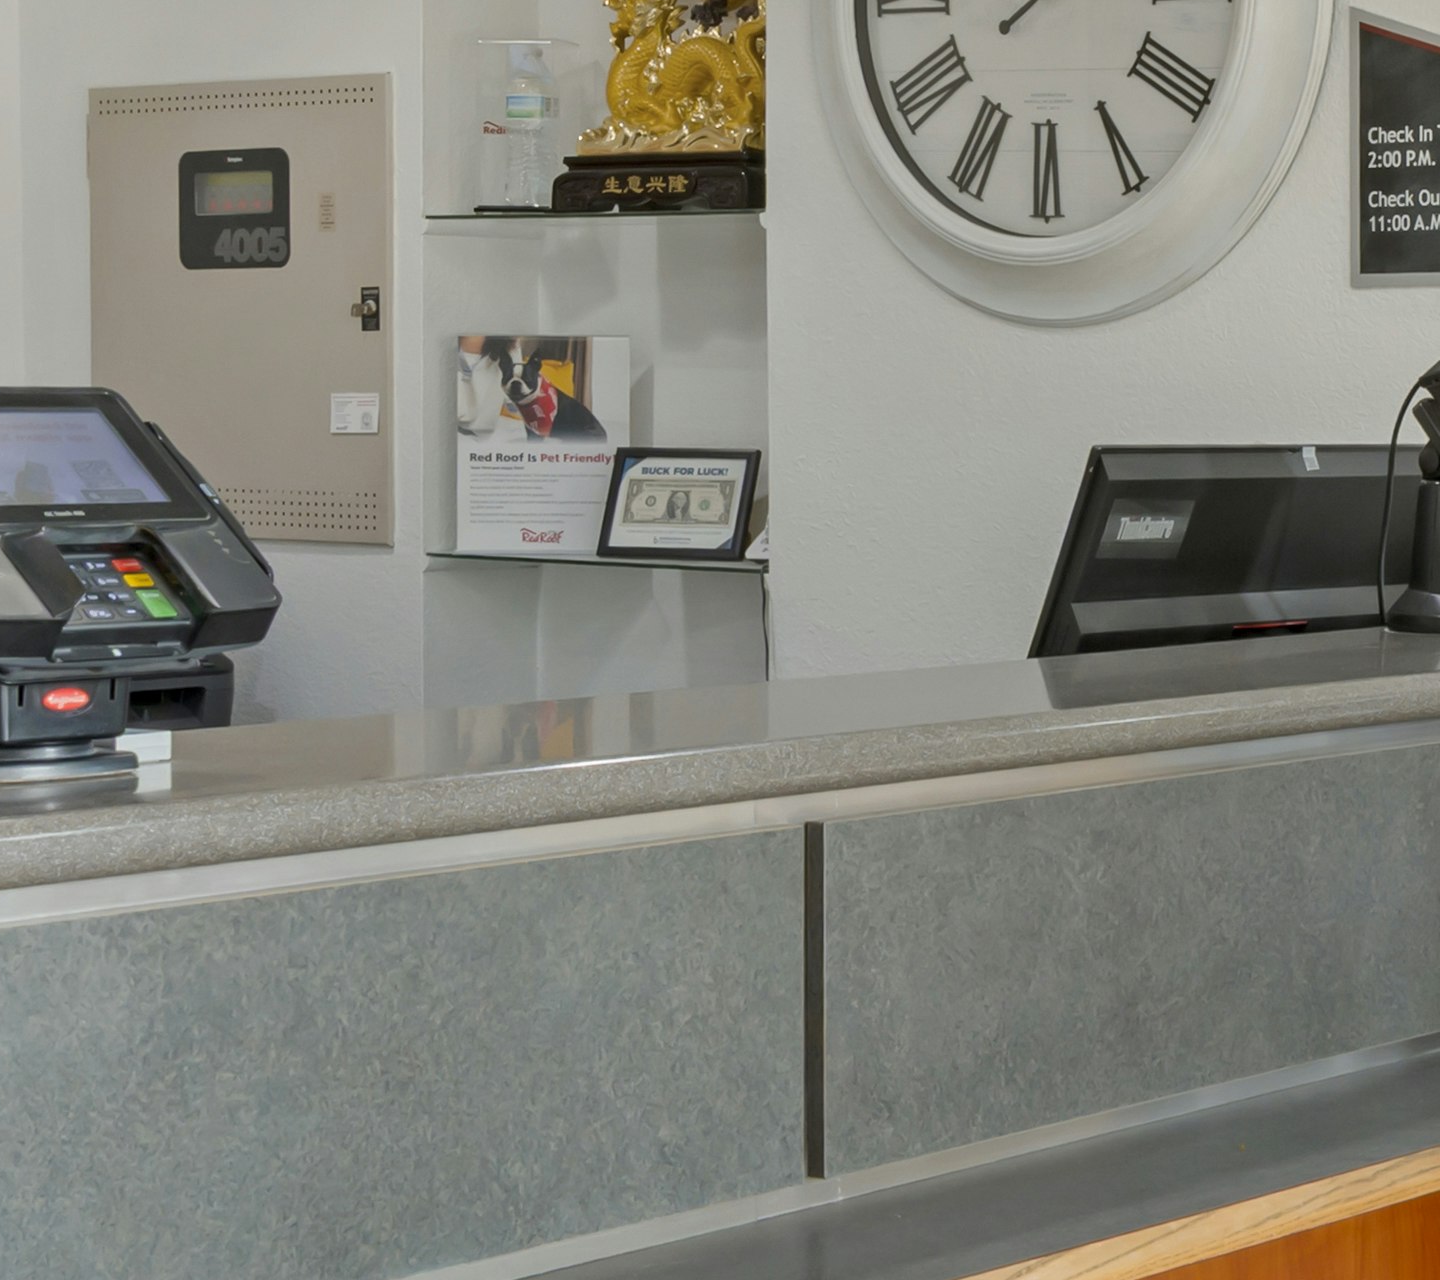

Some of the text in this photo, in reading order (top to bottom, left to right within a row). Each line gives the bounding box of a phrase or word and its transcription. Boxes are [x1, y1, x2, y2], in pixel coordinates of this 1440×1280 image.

[1368, 126, 1414, 144] Check
[1419, 125, 1433, 142] In
[1368, 150, 1436, 168] 2:00 P.M.
[602, 176, 689, 194] 生意兴隆
[1368, 190, 1414, 208] Check
[1369, 215, 1411, 232] 11:00
[214, 227, 288, 263] 4005
[470, 453, 492, 462] Red
[496, 453, 524, 462] Roof
[528, 454, 537, 462] Is
[540, 454, 560, 462] Pet
[642, 467, 728, 476] BUCK FOR LUCK!
